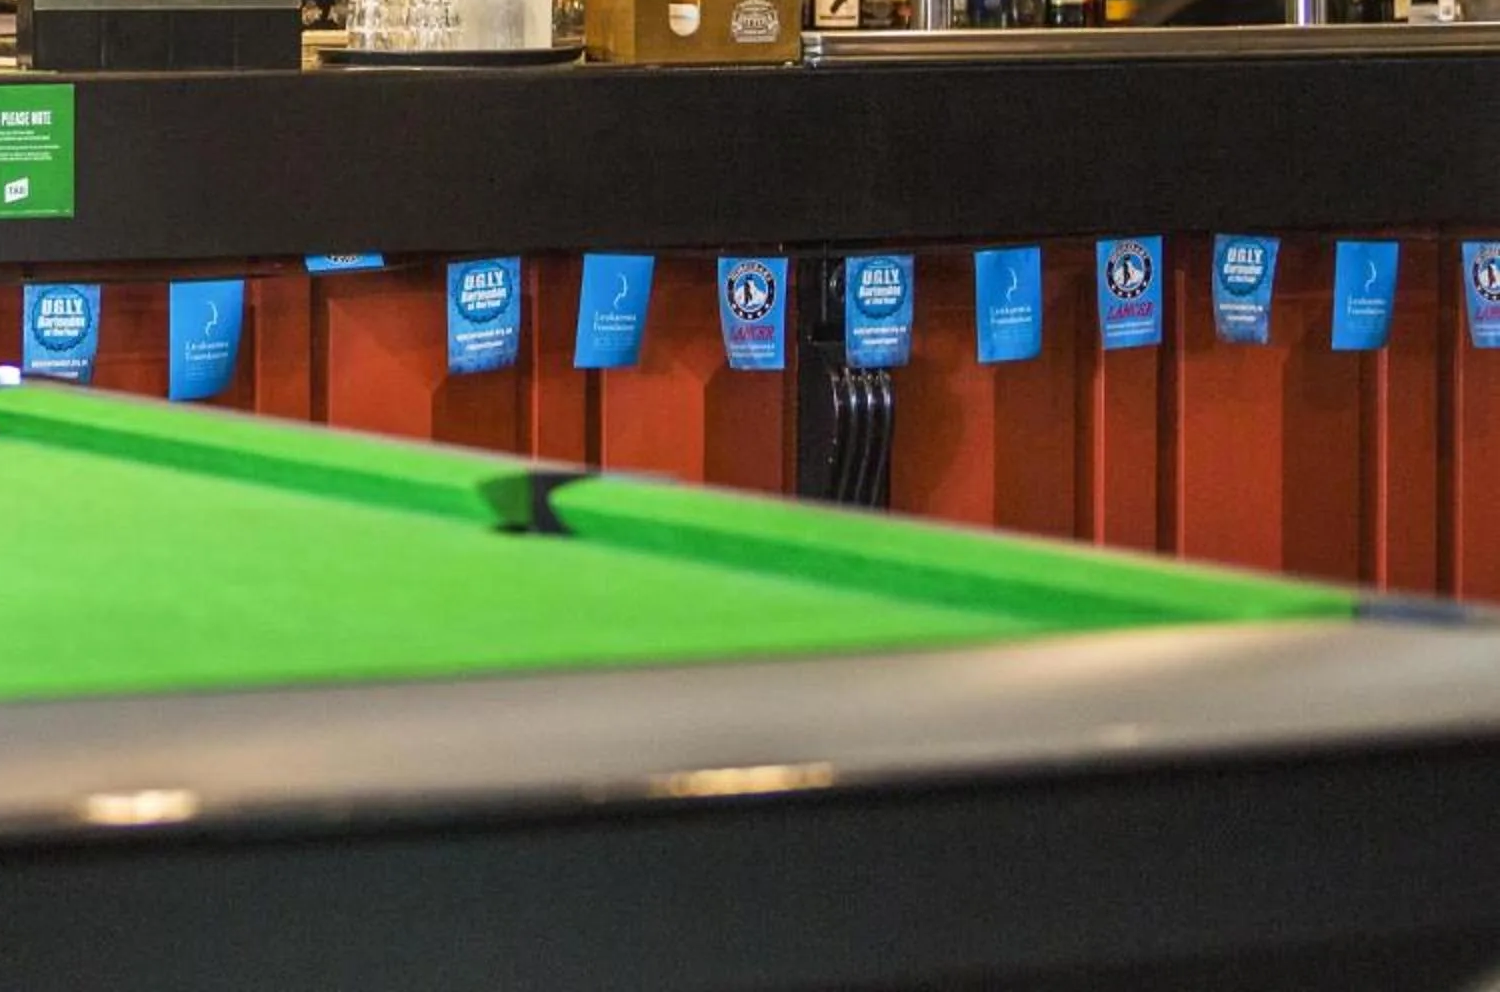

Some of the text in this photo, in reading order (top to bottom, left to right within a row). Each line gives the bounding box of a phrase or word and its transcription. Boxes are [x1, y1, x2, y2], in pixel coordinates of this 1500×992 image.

[1227, 247, 1263, 265] UGLY
[463, 269, 504, 290] UGLY
[861, 267, 901, 286] UGLY
[40, 298, 85, 317] UGLY
